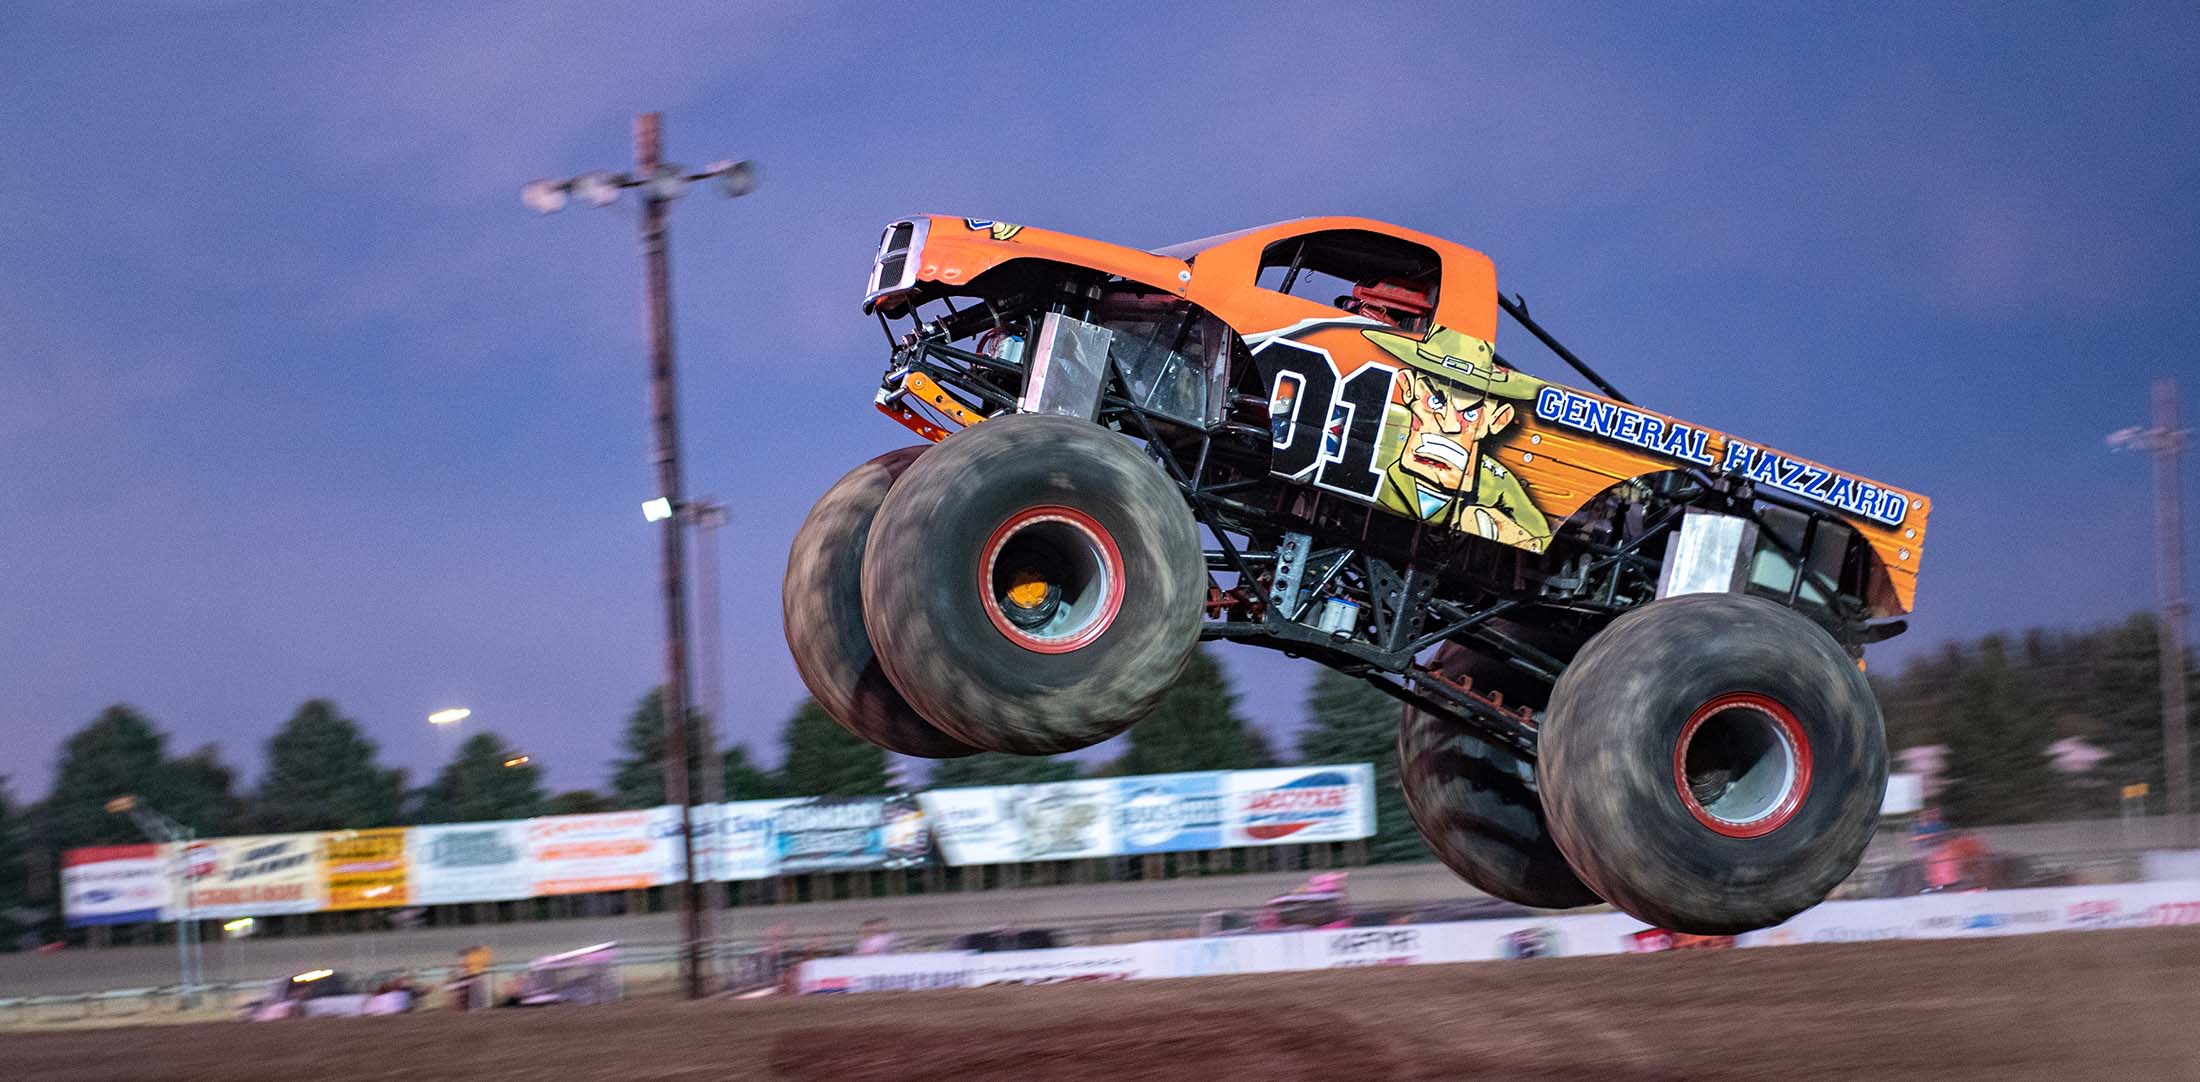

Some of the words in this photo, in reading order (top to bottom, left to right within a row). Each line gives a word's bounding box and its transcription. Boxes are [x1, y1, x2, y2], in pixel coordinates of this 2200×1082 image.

[1251, 336, 1398, 503] 01
[1535, 386, 1715, 467] GENERAL
[1722, 439, 1909, 527] HAZZARD
